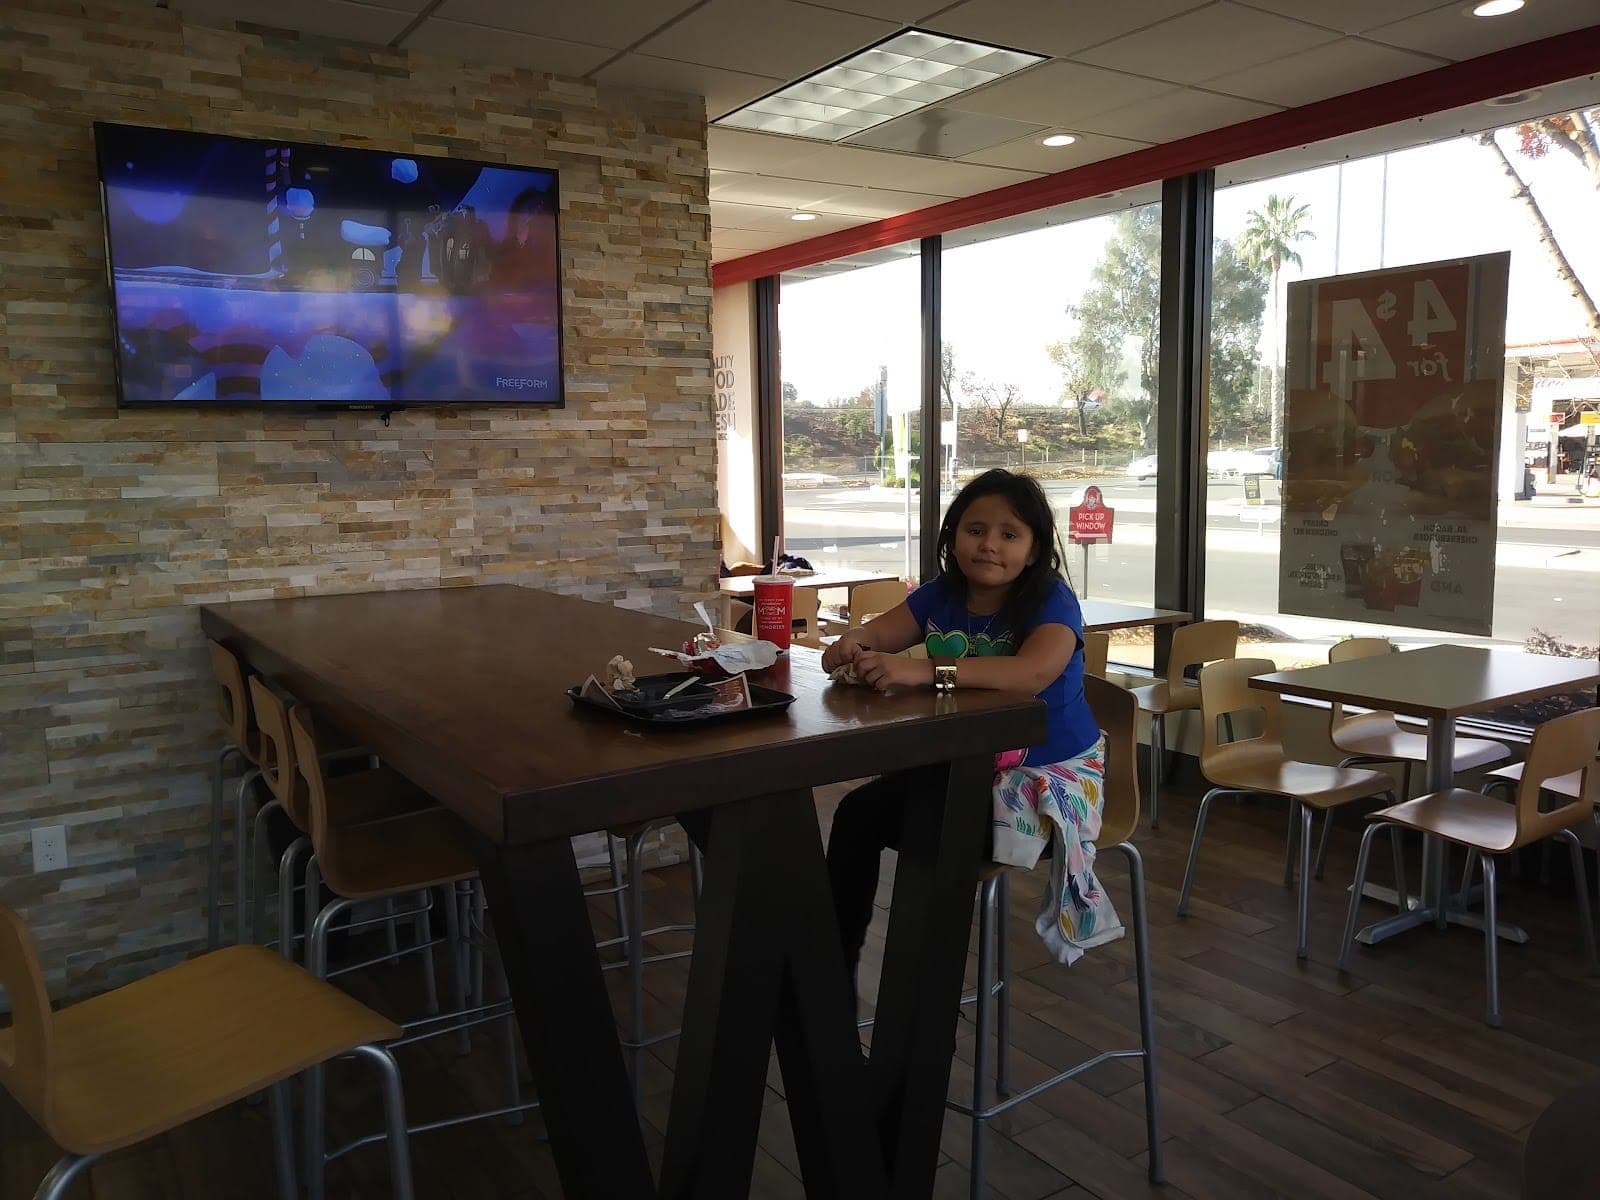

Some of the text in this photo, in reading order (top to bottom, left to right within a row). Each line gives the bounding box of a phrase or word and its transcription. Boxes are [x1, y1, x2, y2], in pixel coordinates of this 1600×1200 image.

[496, 377, 548, 390] FREEFORM
[1078, 513, 1105, 521] PICK UP
[1076, 522, 1106, 530] WINDOW
